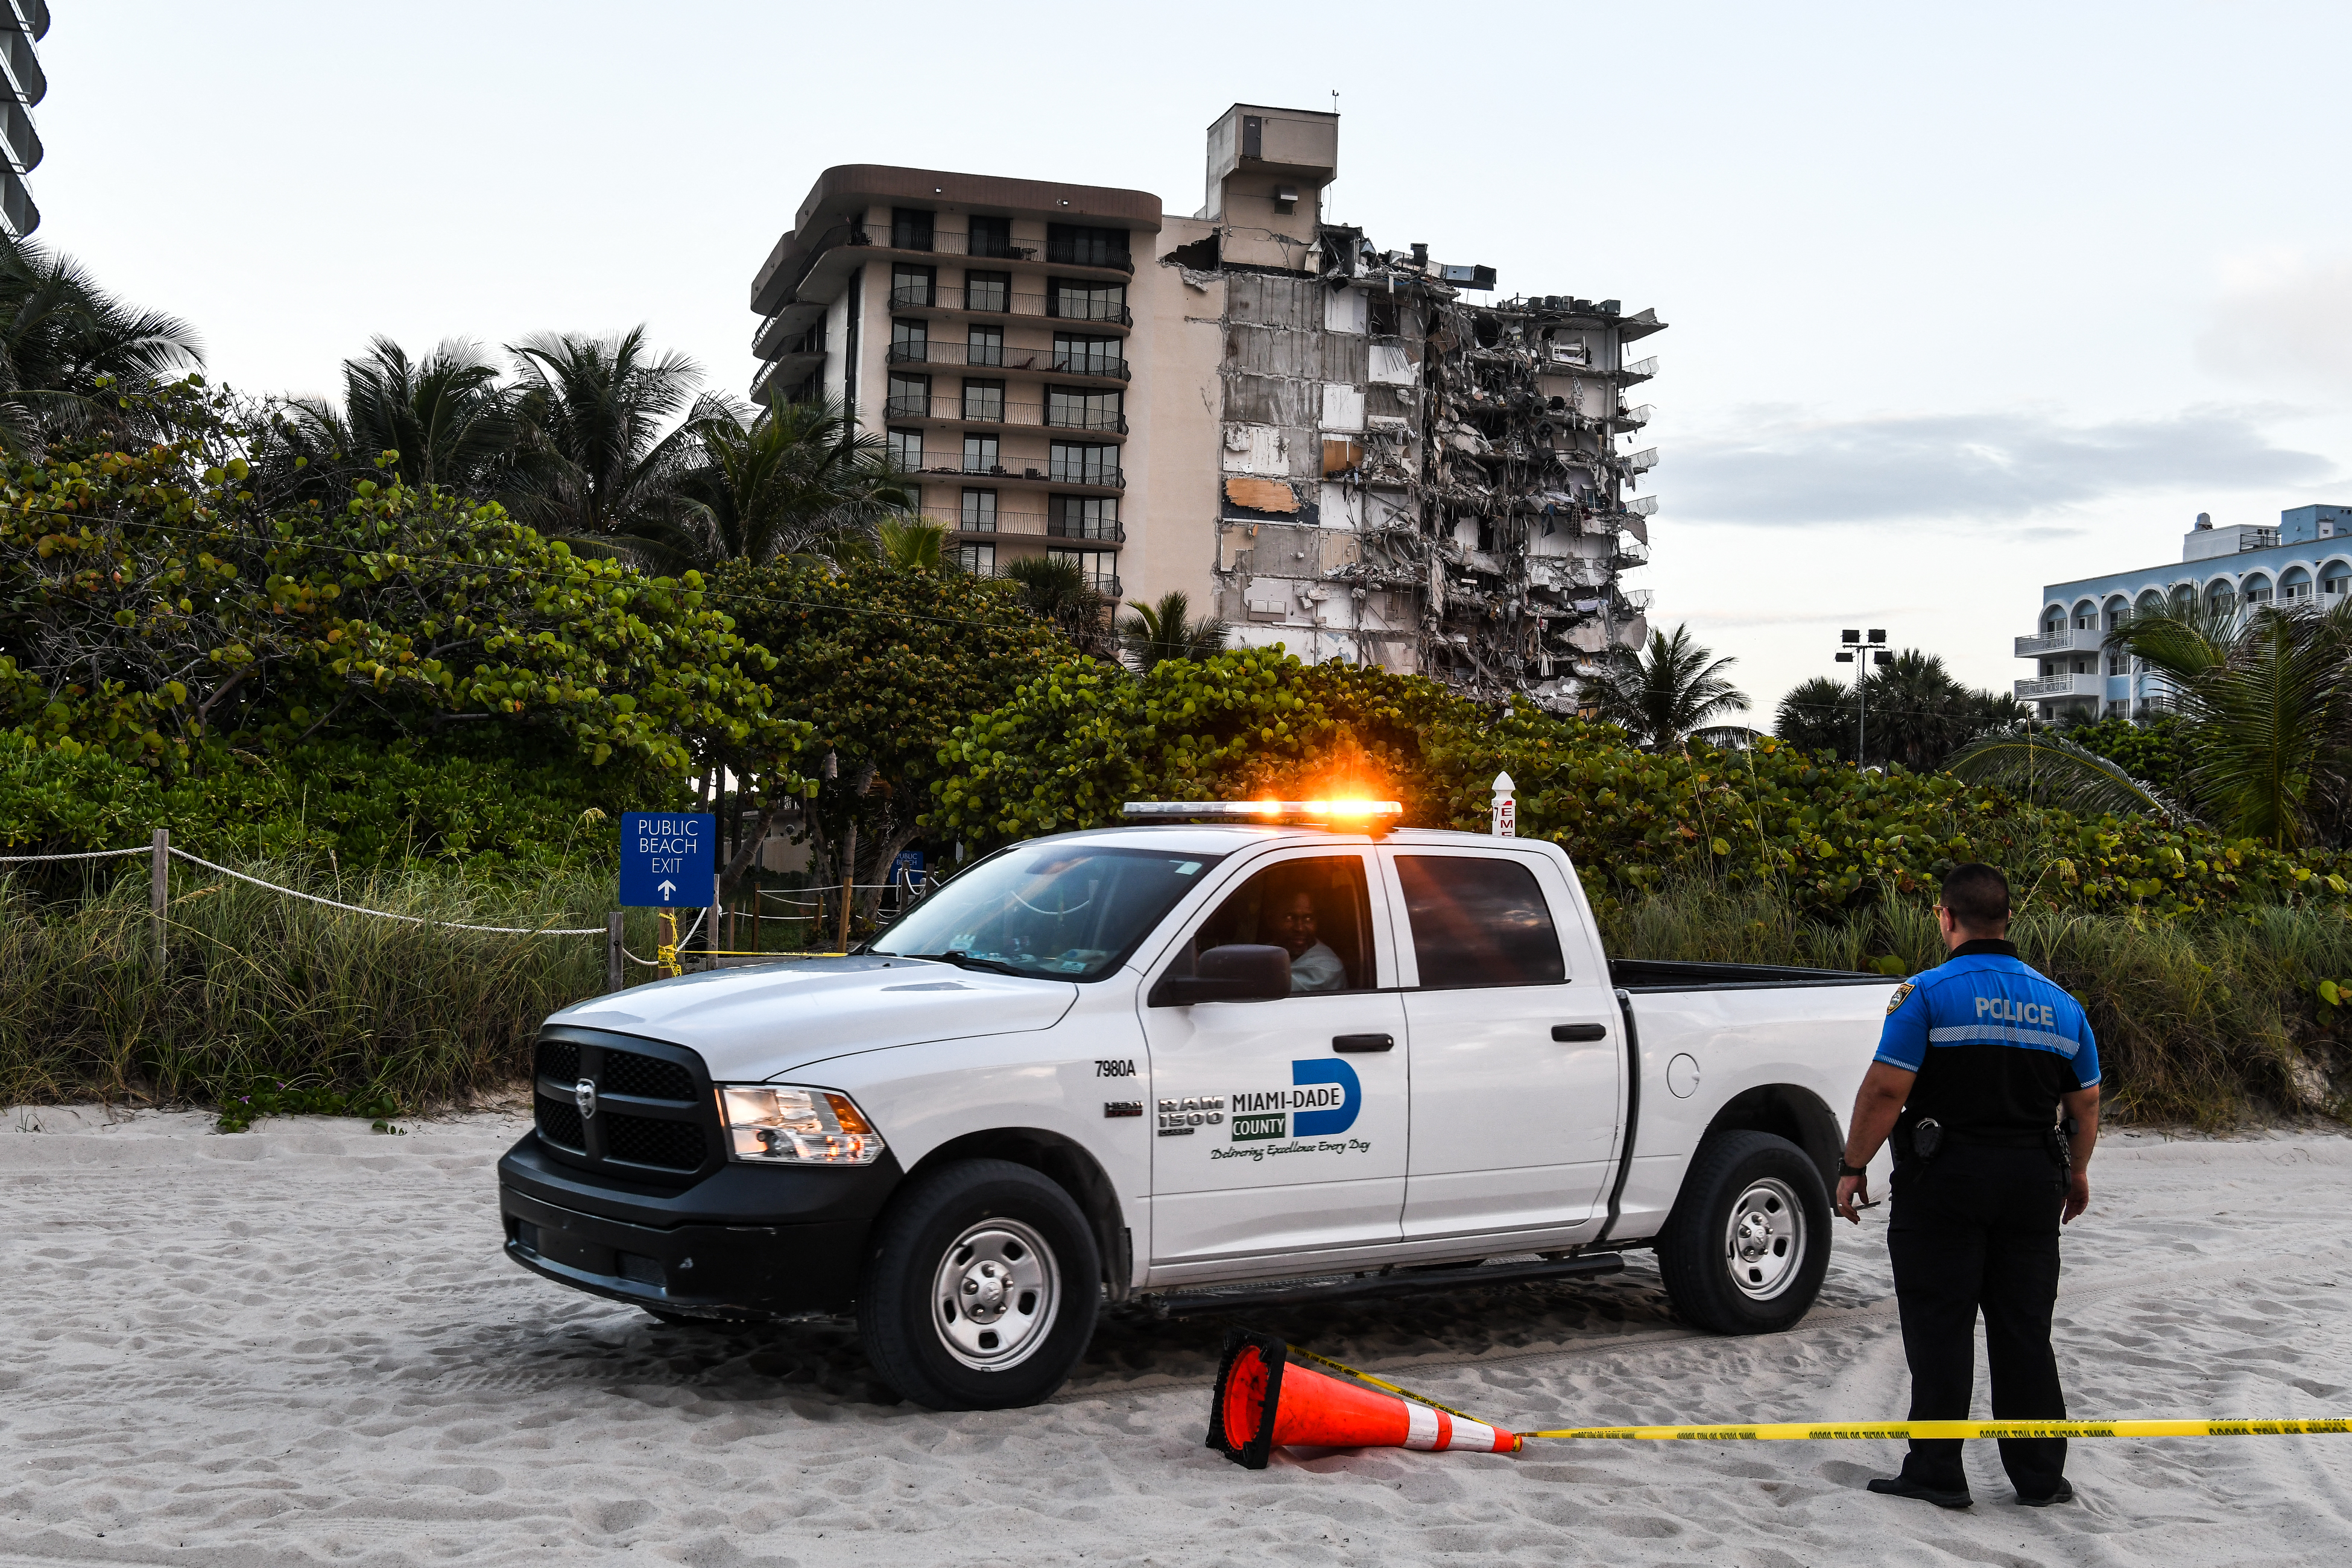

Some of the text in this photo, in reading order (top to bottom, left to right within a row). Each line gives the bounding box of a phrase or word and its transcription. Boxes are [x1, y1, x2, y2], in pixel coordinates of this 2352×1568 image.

[639, 820, 698, 836] PUBLIC
[640, 838, 697, 854] BEACH
[652, 858, 683, 873] EXIT
[1975, 997, 2053, 1026] POLICE
[1095, 1060, 1136, 1076] 7980A
[1159, 1095, 1224, 1112] RAM
[1232, 1088, 1341, 1112] MIAMI-DADE
[1159, 1110, 1224, 1127] 1500
[1233, 1118, 1285, 1136] COUNTY
[1211, 1139, 1371, 1162] Delivering Excellence Every Day
